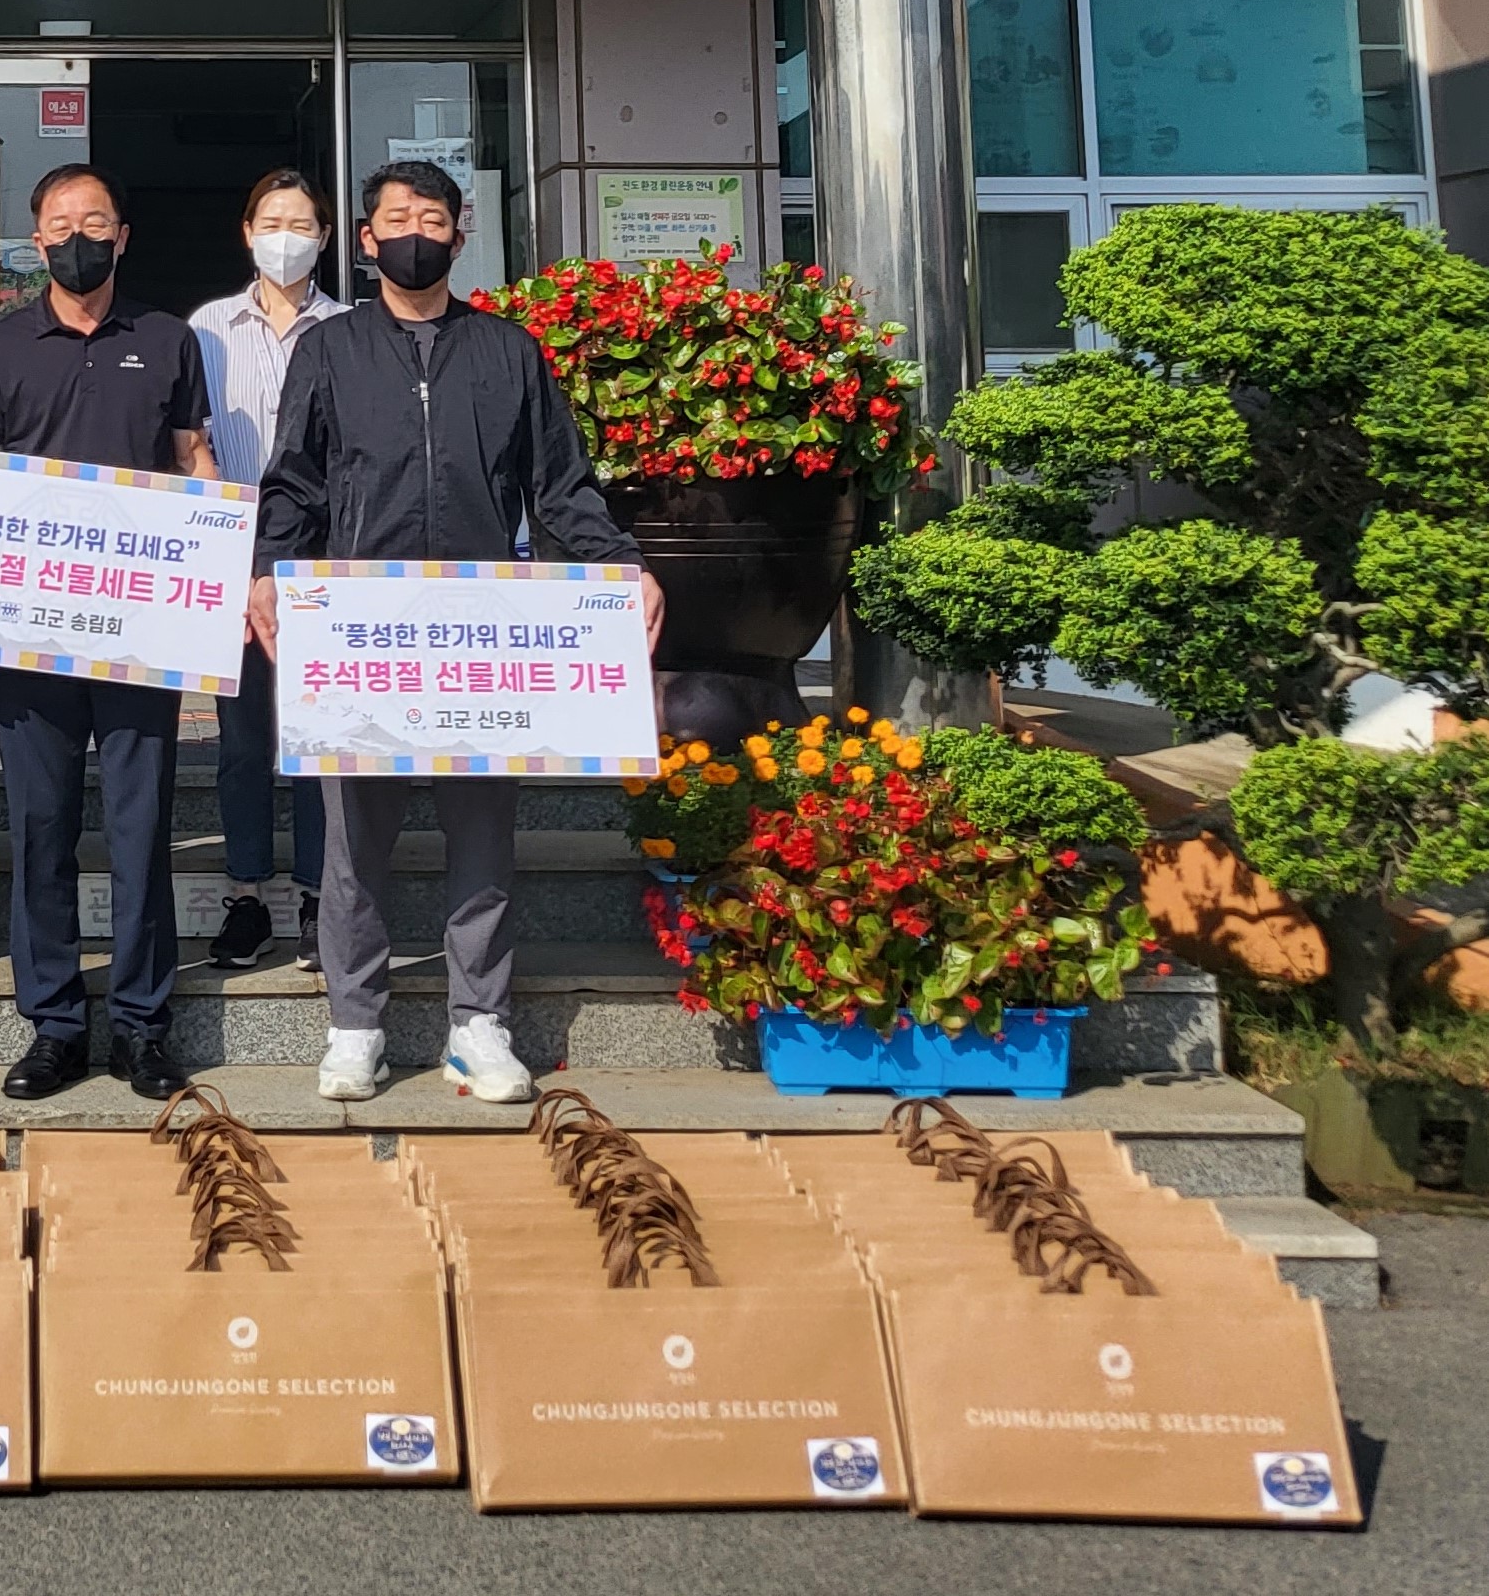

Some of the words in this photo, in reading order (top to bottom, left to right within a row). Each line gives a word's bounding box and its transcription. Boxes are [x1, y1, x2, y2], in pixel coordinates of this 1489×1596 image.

[48, 101, 78, 114] 에스원
[695, 180, 714, 192] 안내
[184, 509, 237, 531] Jindo
[37, 520, 107, 554] 한가위
[114, 531, 200, 563] 되세요”
[38, 556, 155, 602] 선물세트
[166, 576, 224, 612] 기부
[572, 593, 626, 612] Jindo
[28, 606, 65, 629] 고군
[70, 612, 123, 637] 송림회
[331, 622, 419, 649] “풍성한
[426, 622, 499, 649] 한가위
[508, 624, 593, 650] 되세요”
[303, 660, 423, 693] 추석명절
[435, 661, 557, 693] 선물세트
[568, 663, 627, 694] 기부
[435, 710, 472, 730] 고군
[477, 710, 531, 730] 신우회
[94, 1378, 269, 1397] CHUNGJUNGONE
[277, 1377, 397, 1397] SELECTION
[531, 1399, 711, 1422] CHUNGJUNGONE
[718, 1399, 839, 1420] SELECTION
[964, 1407, 1151, 1432] CHUNGJUNGONE
[1158, 1413, 1286, 1434] SELECTION
